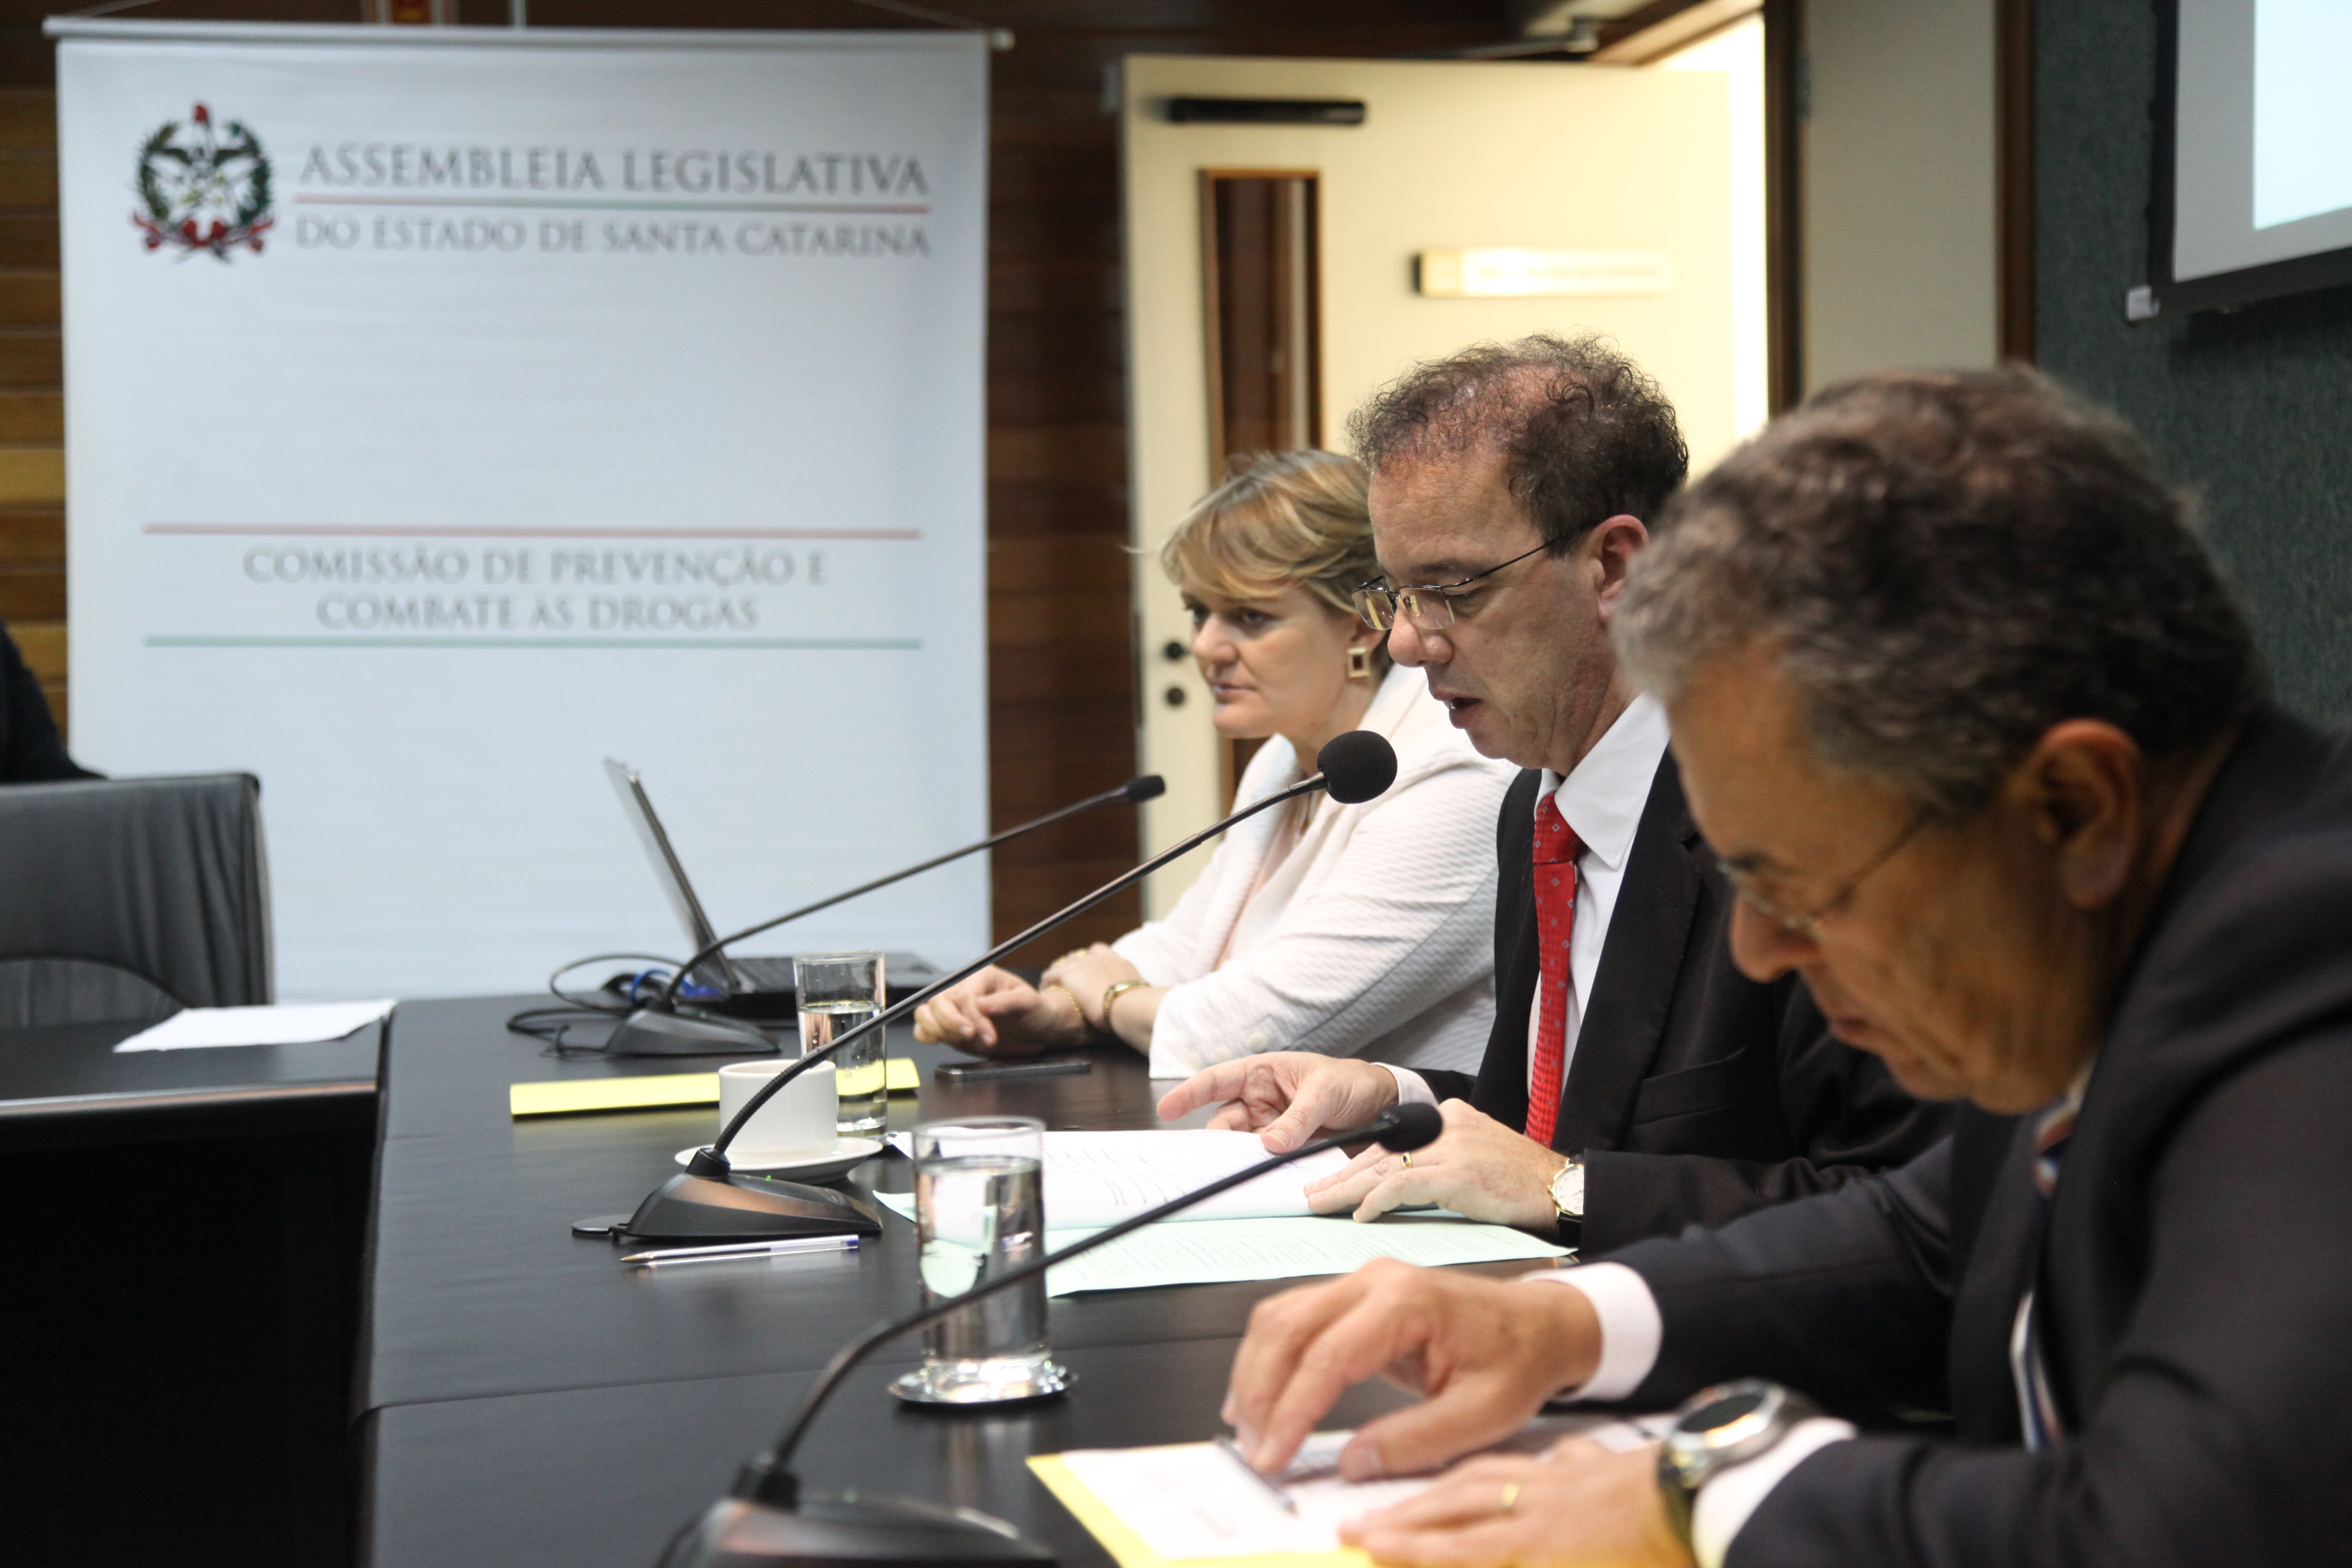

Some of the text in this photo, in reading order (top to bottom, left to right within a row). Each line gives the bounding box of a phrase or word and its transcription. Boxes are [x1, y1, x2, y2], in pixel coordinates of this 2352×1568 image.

[301, 142, 929, 195] ASSEMBLEIA LEGISLATIVA
[297, 215, 931, 259] DO ESTADO DE SANTA CATARINA
[242, 541, 830, 591] COMISSÃO DE PREVENÇÃO E
[315, 591, 519, 631] COMBATE
[588, 593, 760, 632] DROGAS
